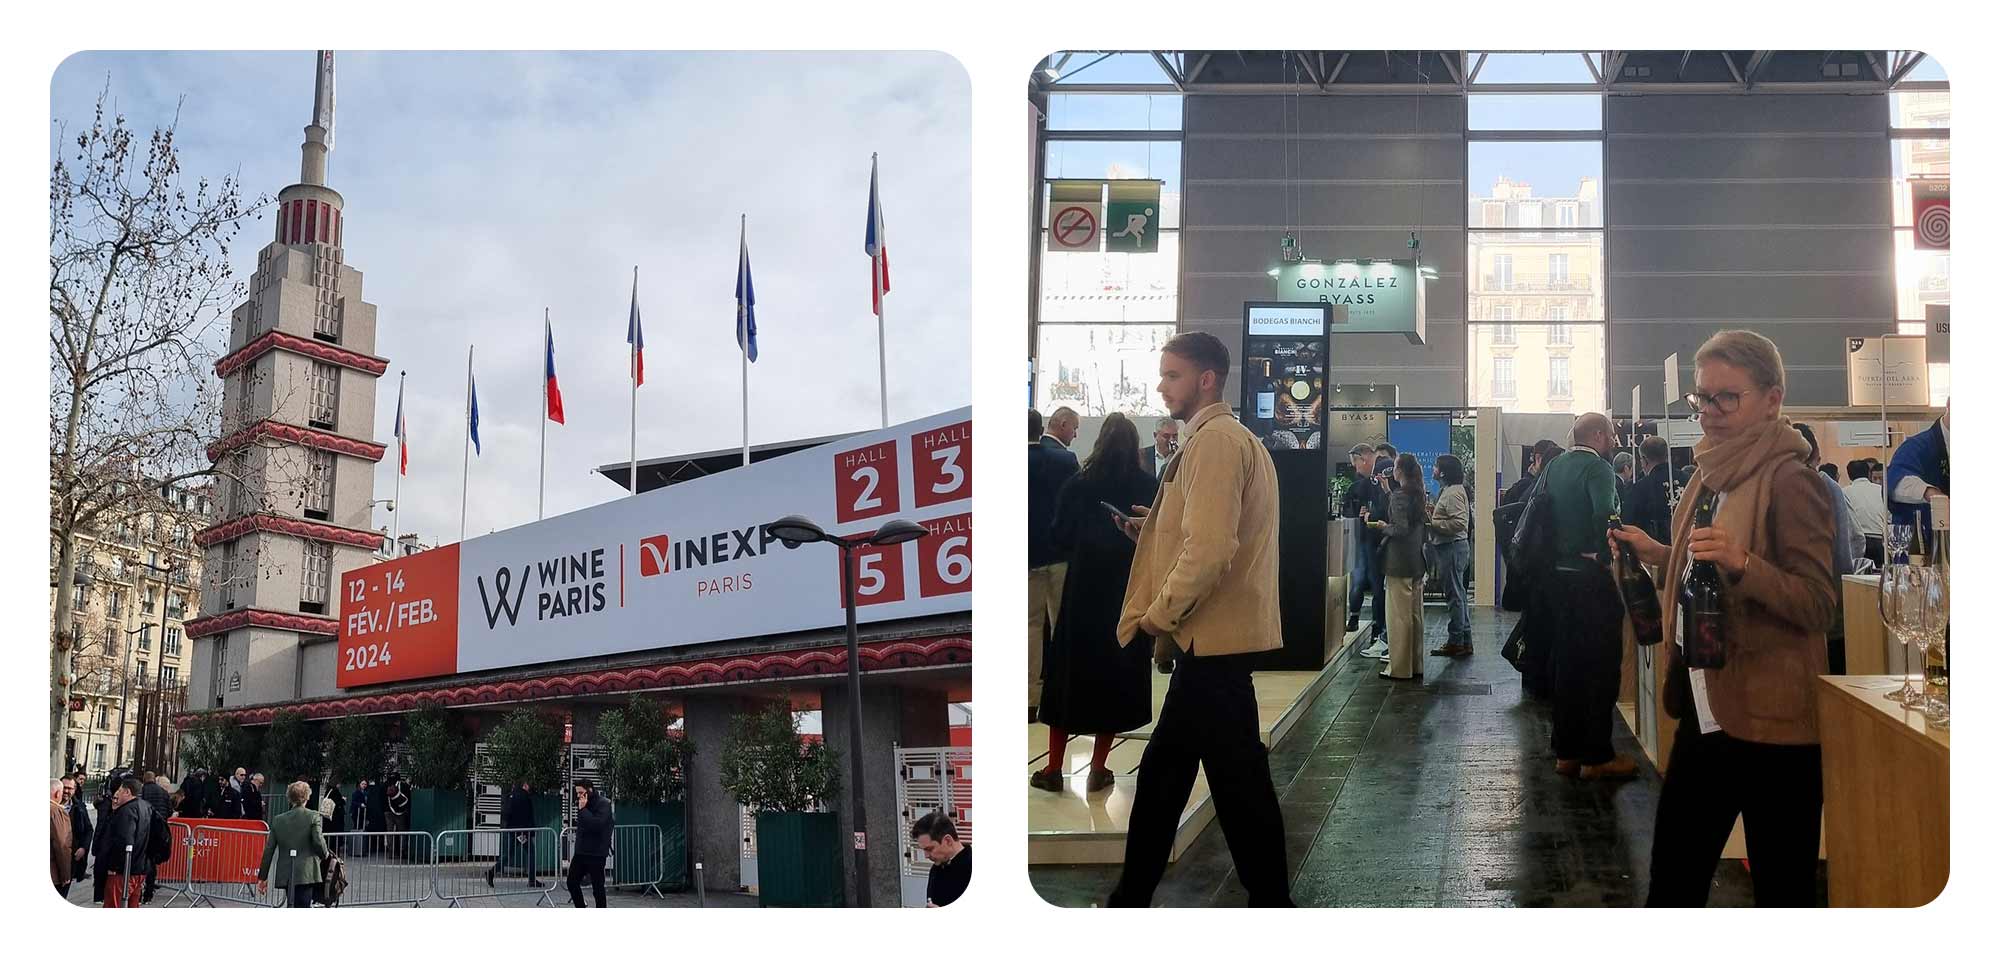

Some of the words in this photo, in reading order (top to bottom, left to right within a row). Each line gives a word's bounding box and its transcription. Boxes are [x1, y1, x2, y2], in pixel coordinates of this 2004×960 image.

[1319, 294, 1375, 304] BYASS
[1253, 317, 1289, 325] BODEGAS
[1290, 317, 1321, 325] BIANCHI
[1341, 413, 1375, 421] BYASS
[924, 426, 970, 448] HALL
[845, 447, 887, 468] HALL
[931, 445, 965, 494] 3
[851, 466, 882, 512] 2
[640, 522, 802, 577] VINEXP
[936, 536, 972, 584] 6
[538, 548, 605, 589] WINE
[857, 552, 886, 596] 5
[349, 579, 365, 603] 12
[385, 569, 405, 595] 14
[698, 573, 753, 598] PARIS
[538, 582, 606, 621] PARIS
[345, 642, 392, 671] 2024
[182, 837, 219, 847] SORTIE
